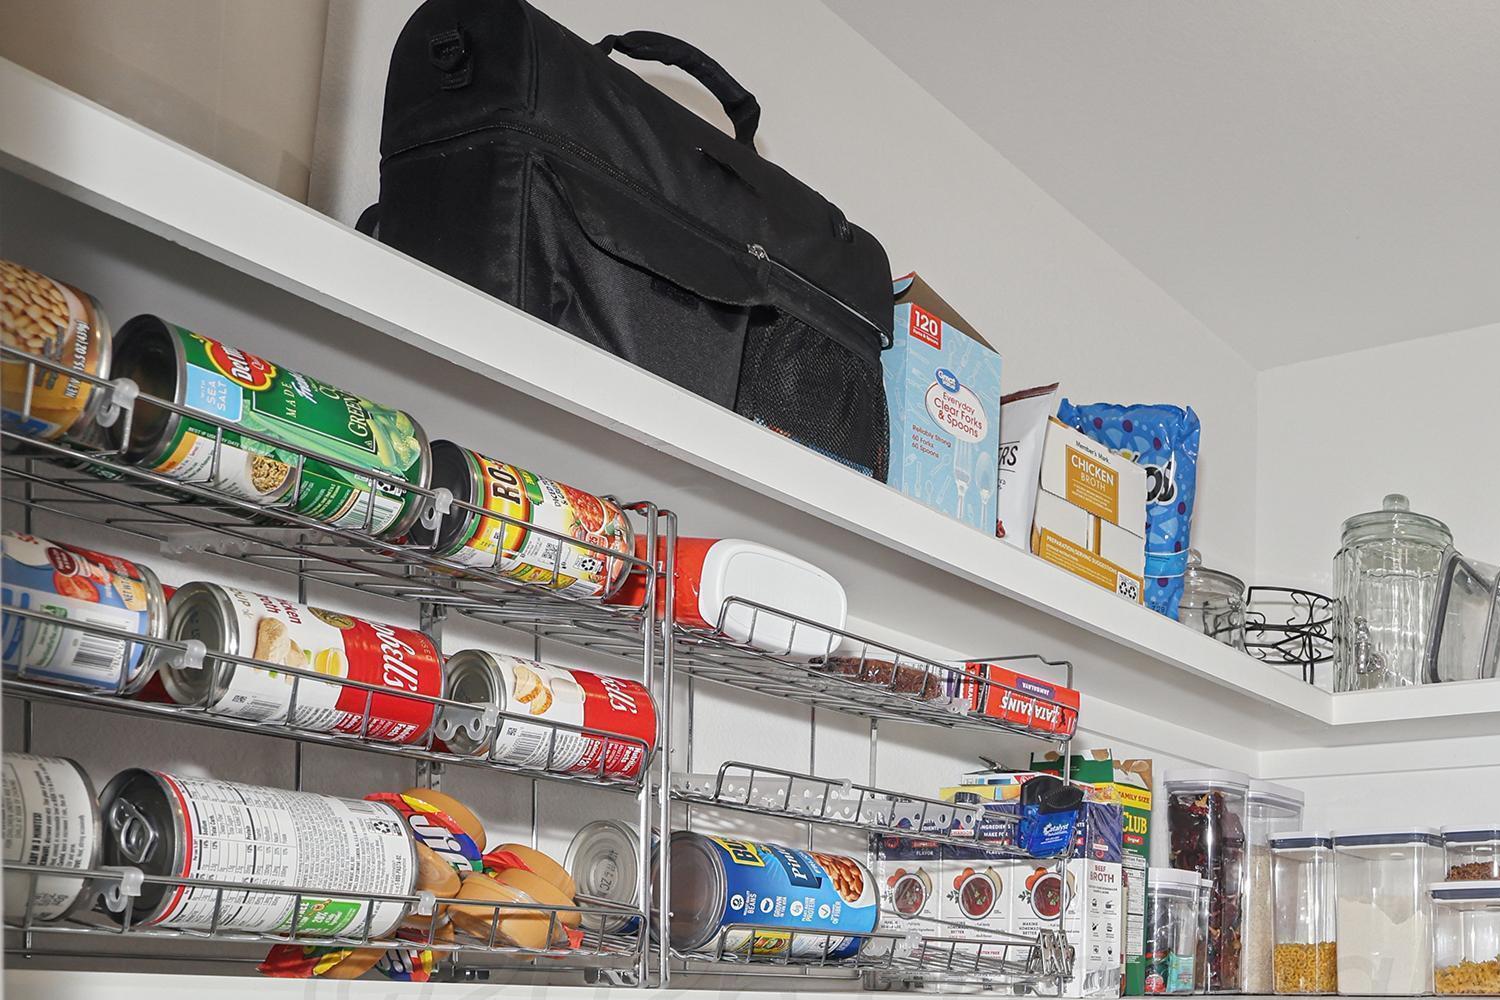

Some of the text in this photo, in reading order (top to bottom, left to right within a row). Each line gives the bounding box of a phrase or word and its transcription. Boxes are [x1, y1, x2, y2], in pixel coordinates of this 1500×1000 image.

[914, 311, 938, 336] 120
[207, 380, 217, 405] SEA
[217, 379, 227, 411] SALT
[281, 382, 297, 418] MADE
[943, 392, 975, 415] Everyday
[934, 398, 982, 429] Clear Forks
[938, 410, 978, 438] & Spoons
[1071, 454, 1114, 486] CHICKEN
[1081, 472, 1105, 491] BROTH
[1138, 795, 1150, 804] SIZE
[1090, 872, 1115, 884] BROTH
[1095, 864, 1106, 872] BEEF
[747, 893, 757, 914] BEANS
[806, 897, 816, 922] PROTEIN
